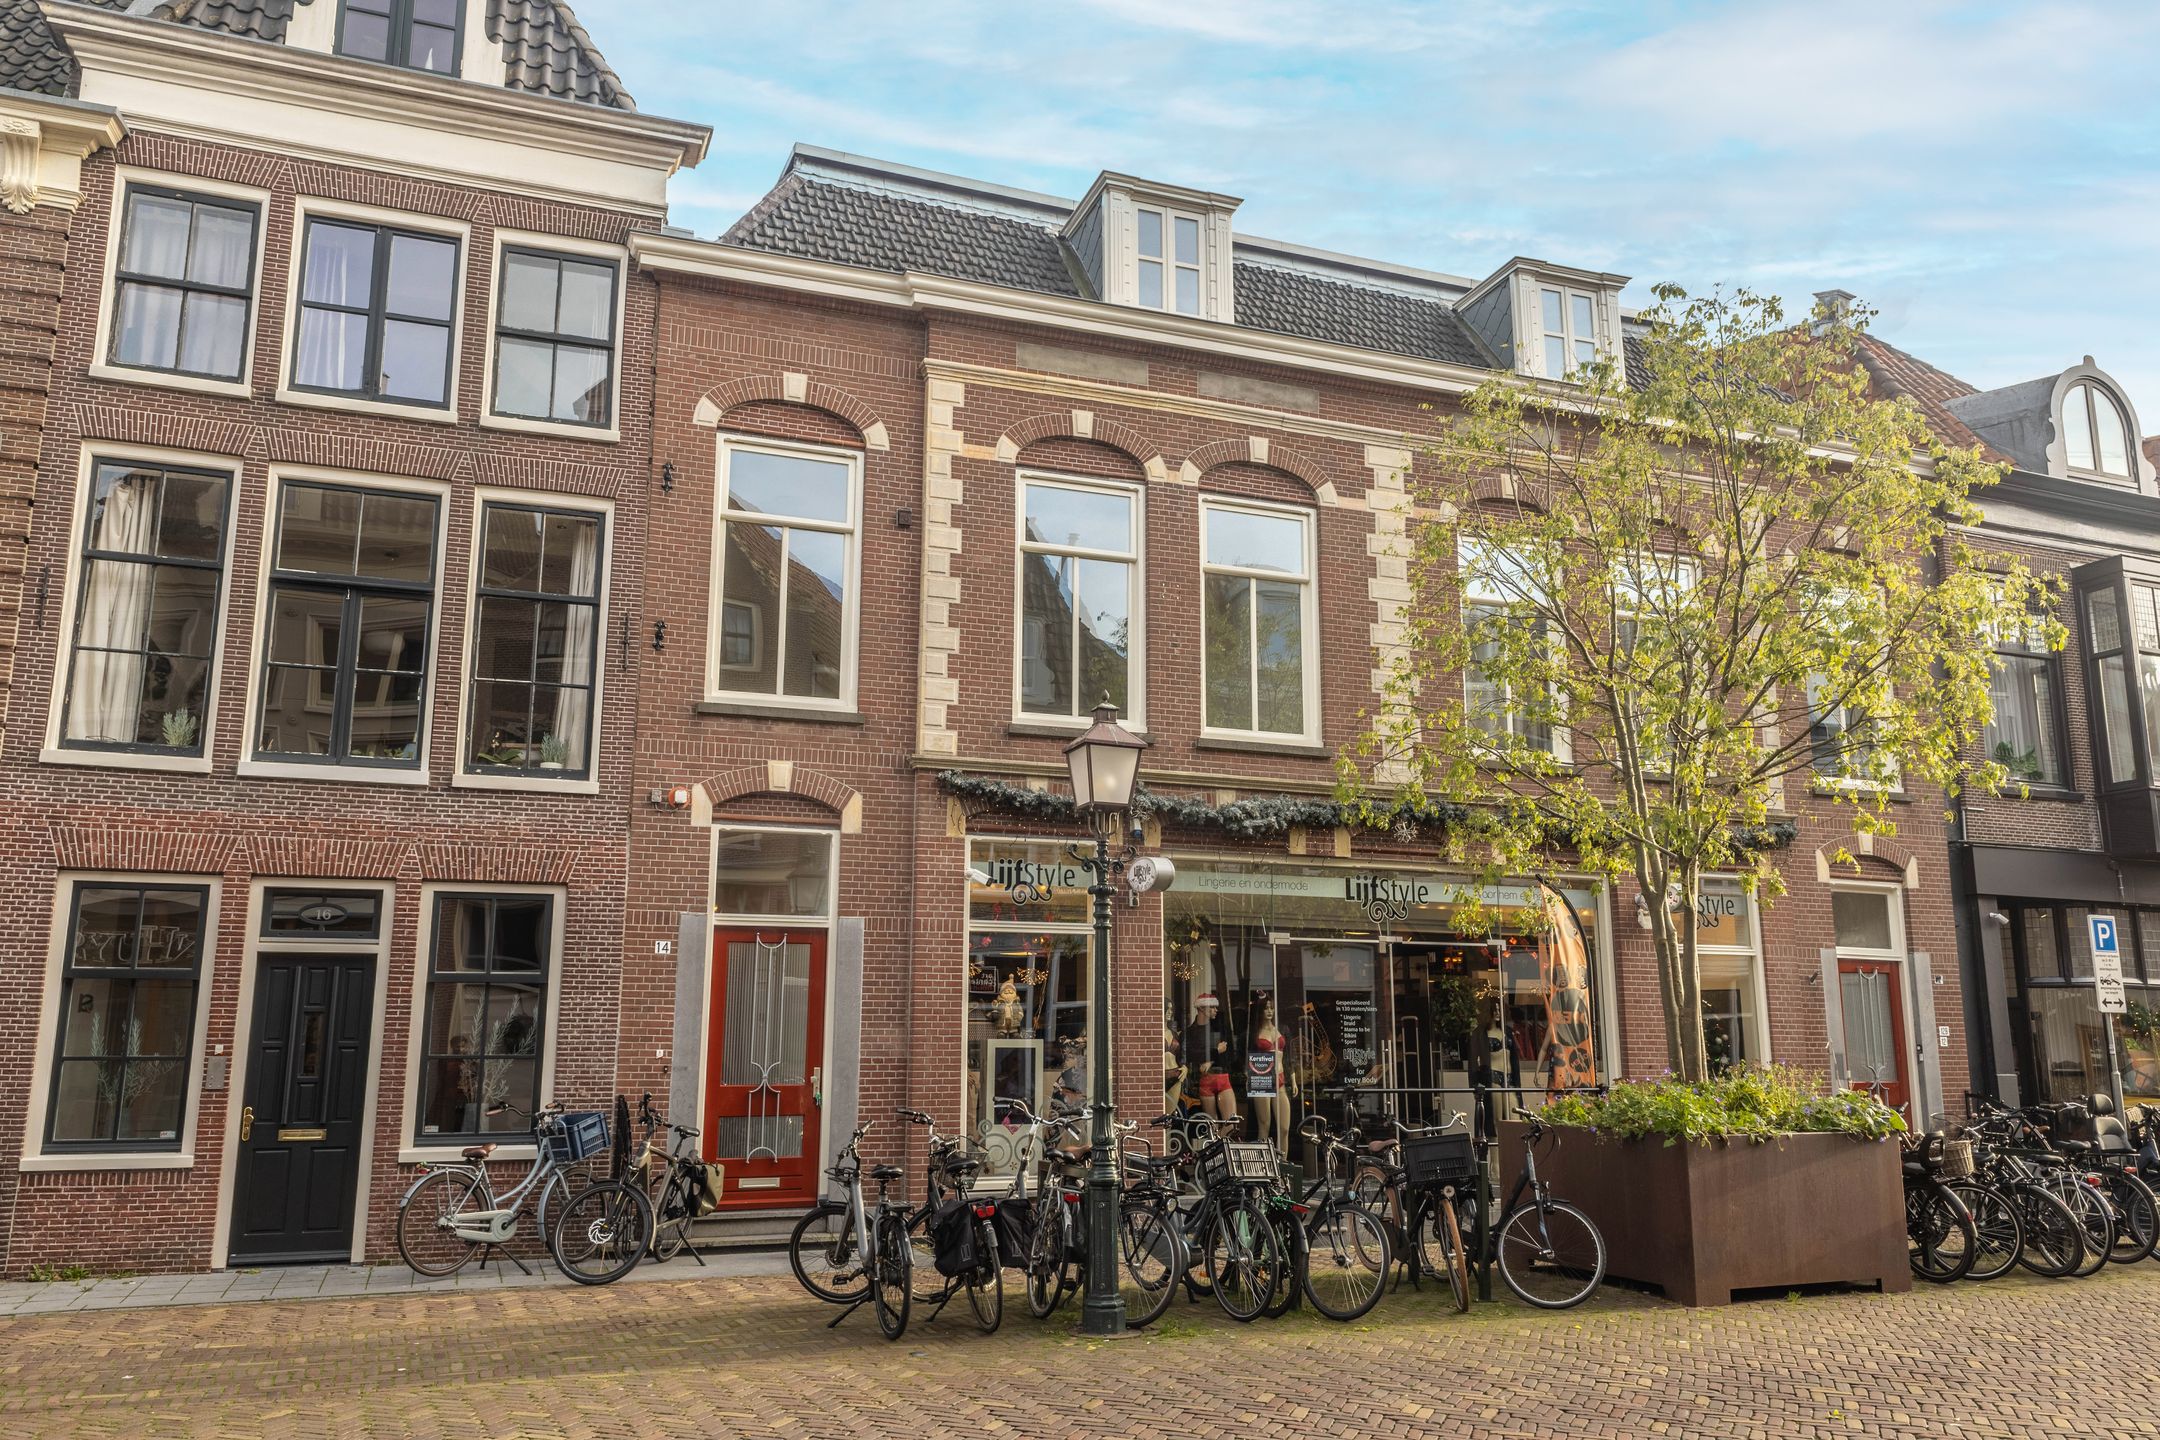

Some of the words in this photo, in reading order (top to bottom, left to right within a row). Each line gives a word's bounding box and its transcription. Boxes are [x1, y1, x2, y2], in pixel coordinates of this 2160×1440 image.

[988, 858, 1075, 901] LijfStyle
[1199, 875, 1236, 890] Lingerie
[1239, 879, 1251, 888] en
[1254, 880, 1309, 891] ondermode
[1345, 874, 1429, 918] LijfStyle
[316, 909, 332, 920] 16
[2097, 922, 2111, 948] P
[657, 941, 670, 954] 14
